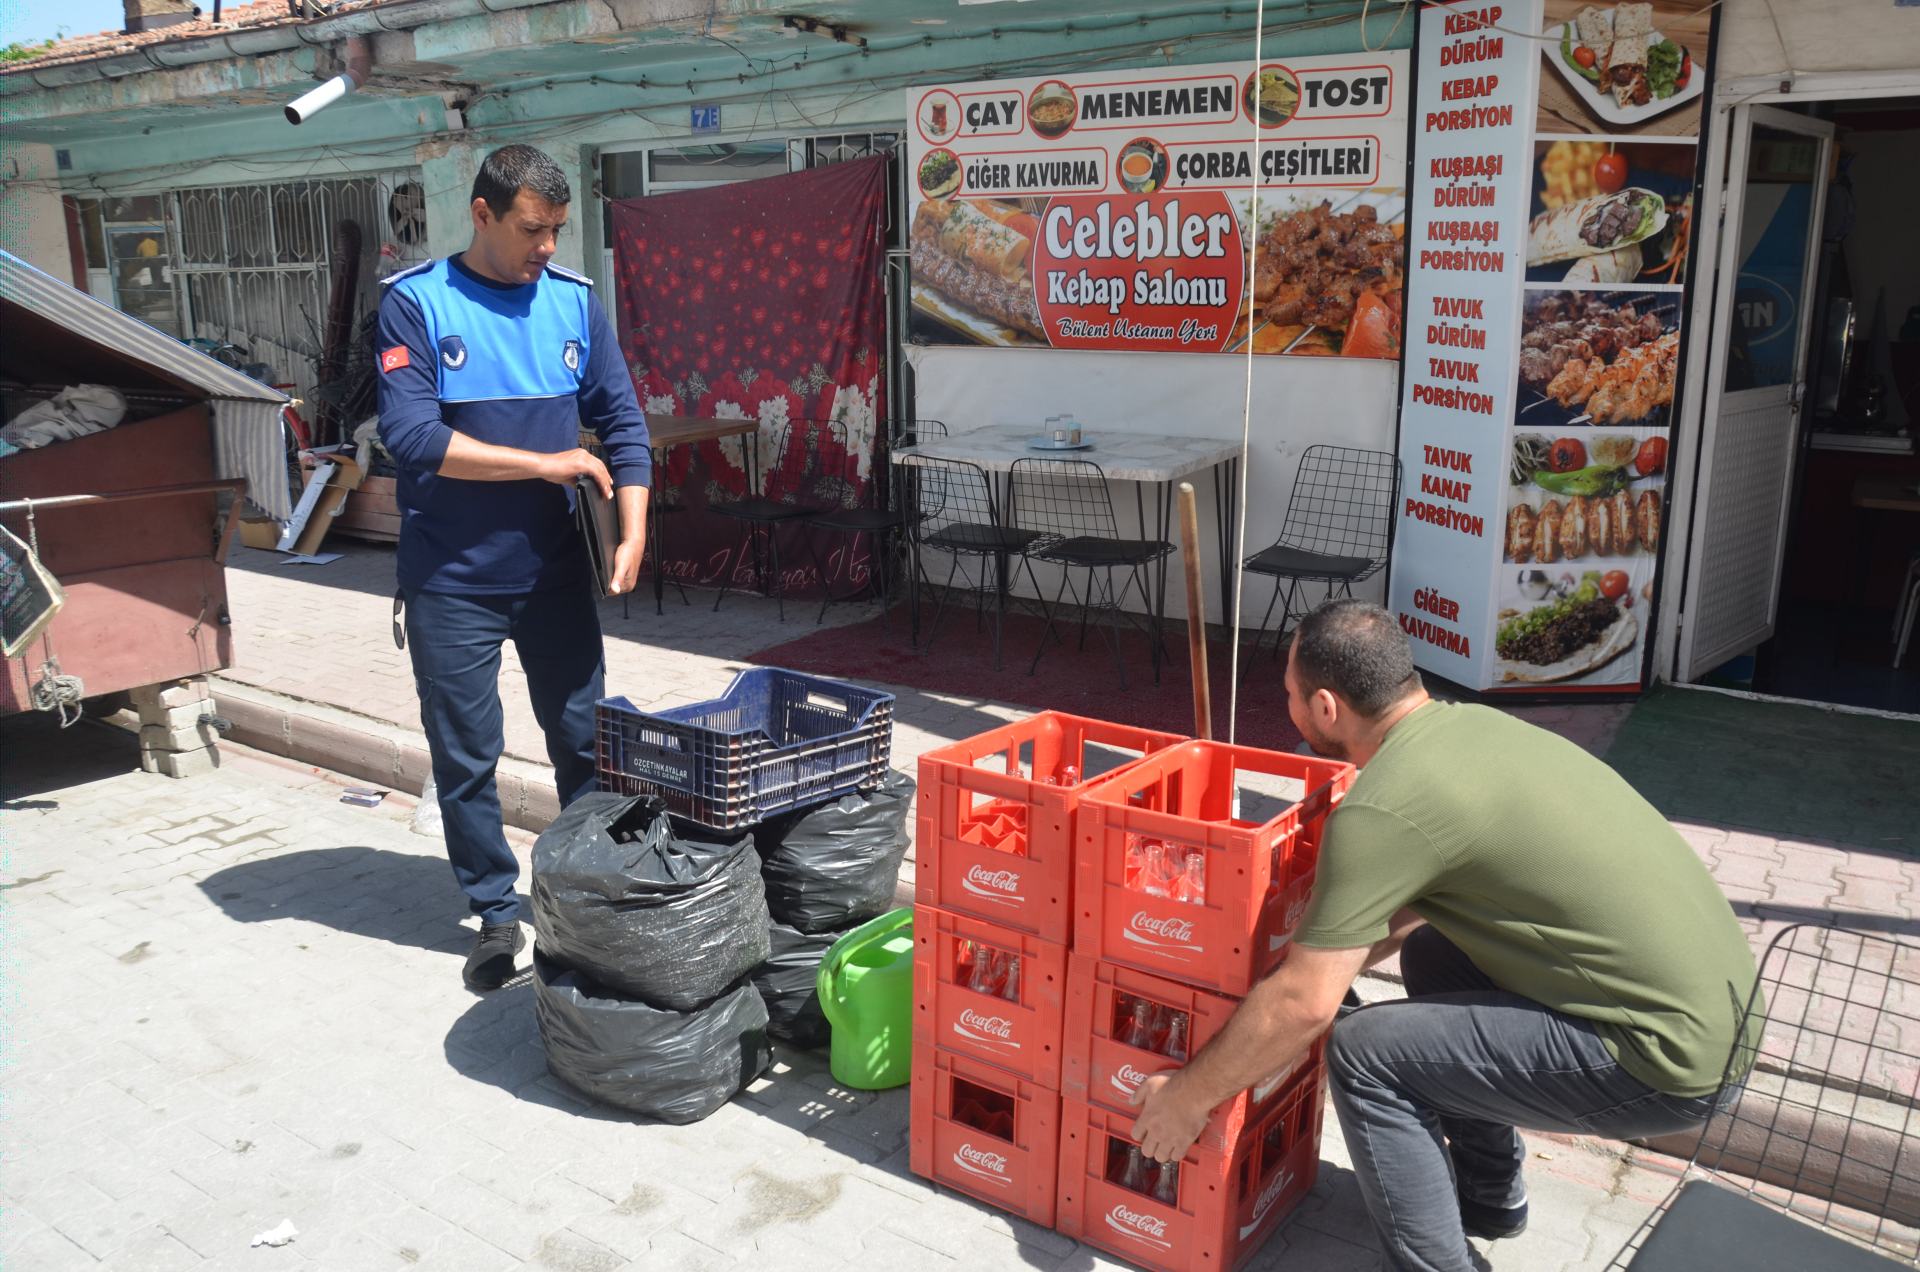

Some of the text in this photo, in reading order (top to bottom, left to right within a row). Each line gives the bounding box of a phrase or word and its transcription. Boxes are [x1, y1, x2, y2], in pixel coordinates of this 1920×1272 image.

[1444, 7, 1502, 35] KEBAP
[1440, 36, 1503, 66] DÜRÜM
[1081, 84, 1233, 120] MENEMEN
[1305, 77, 1388, 108] TOST
[1441, 75, 1498, 100] KEBAP
[966, 101, 1018, 134] ÇAY
[1426, 103, 1512, 132] PORSİYON
[966, 158, 1099, 190] CİĞER KAVURMA
[1176, 139, 1370, 187] ÇORBA ÇEŞİTLERİ
[1430, 155, 1502, 182] KUŞBAŞI
[1434, 182, 1495, 207] DÜRÜM
[1045, 199, 1231, 263] Celebler
[1428, 221, 1499, 246] KUŞBAŞI
[1420, 247, 1504, 272] PORSİYON
[1047, 267, 1228, 315] Kebap Salonu
[1433, 297, 1483, 319] TAVUK
[1057, 317, 1218, 344] Bülent Ustanın Yeri
[1427, 321, 1486, 350] DÜRÜM
[1430, 358, 1479, 383] TAVUK
[1413, 385, 1493, 415] PORSİYON
[1424, 445, 1472, 474] TAVUK
[1421, 474, 1471, 503] KANAT
[1405, 498, 1483, 537] PORSİYON
[1413, 585, 1460, 623] CİĞER
[1400, 614, 1470, 658] KAVURMA
